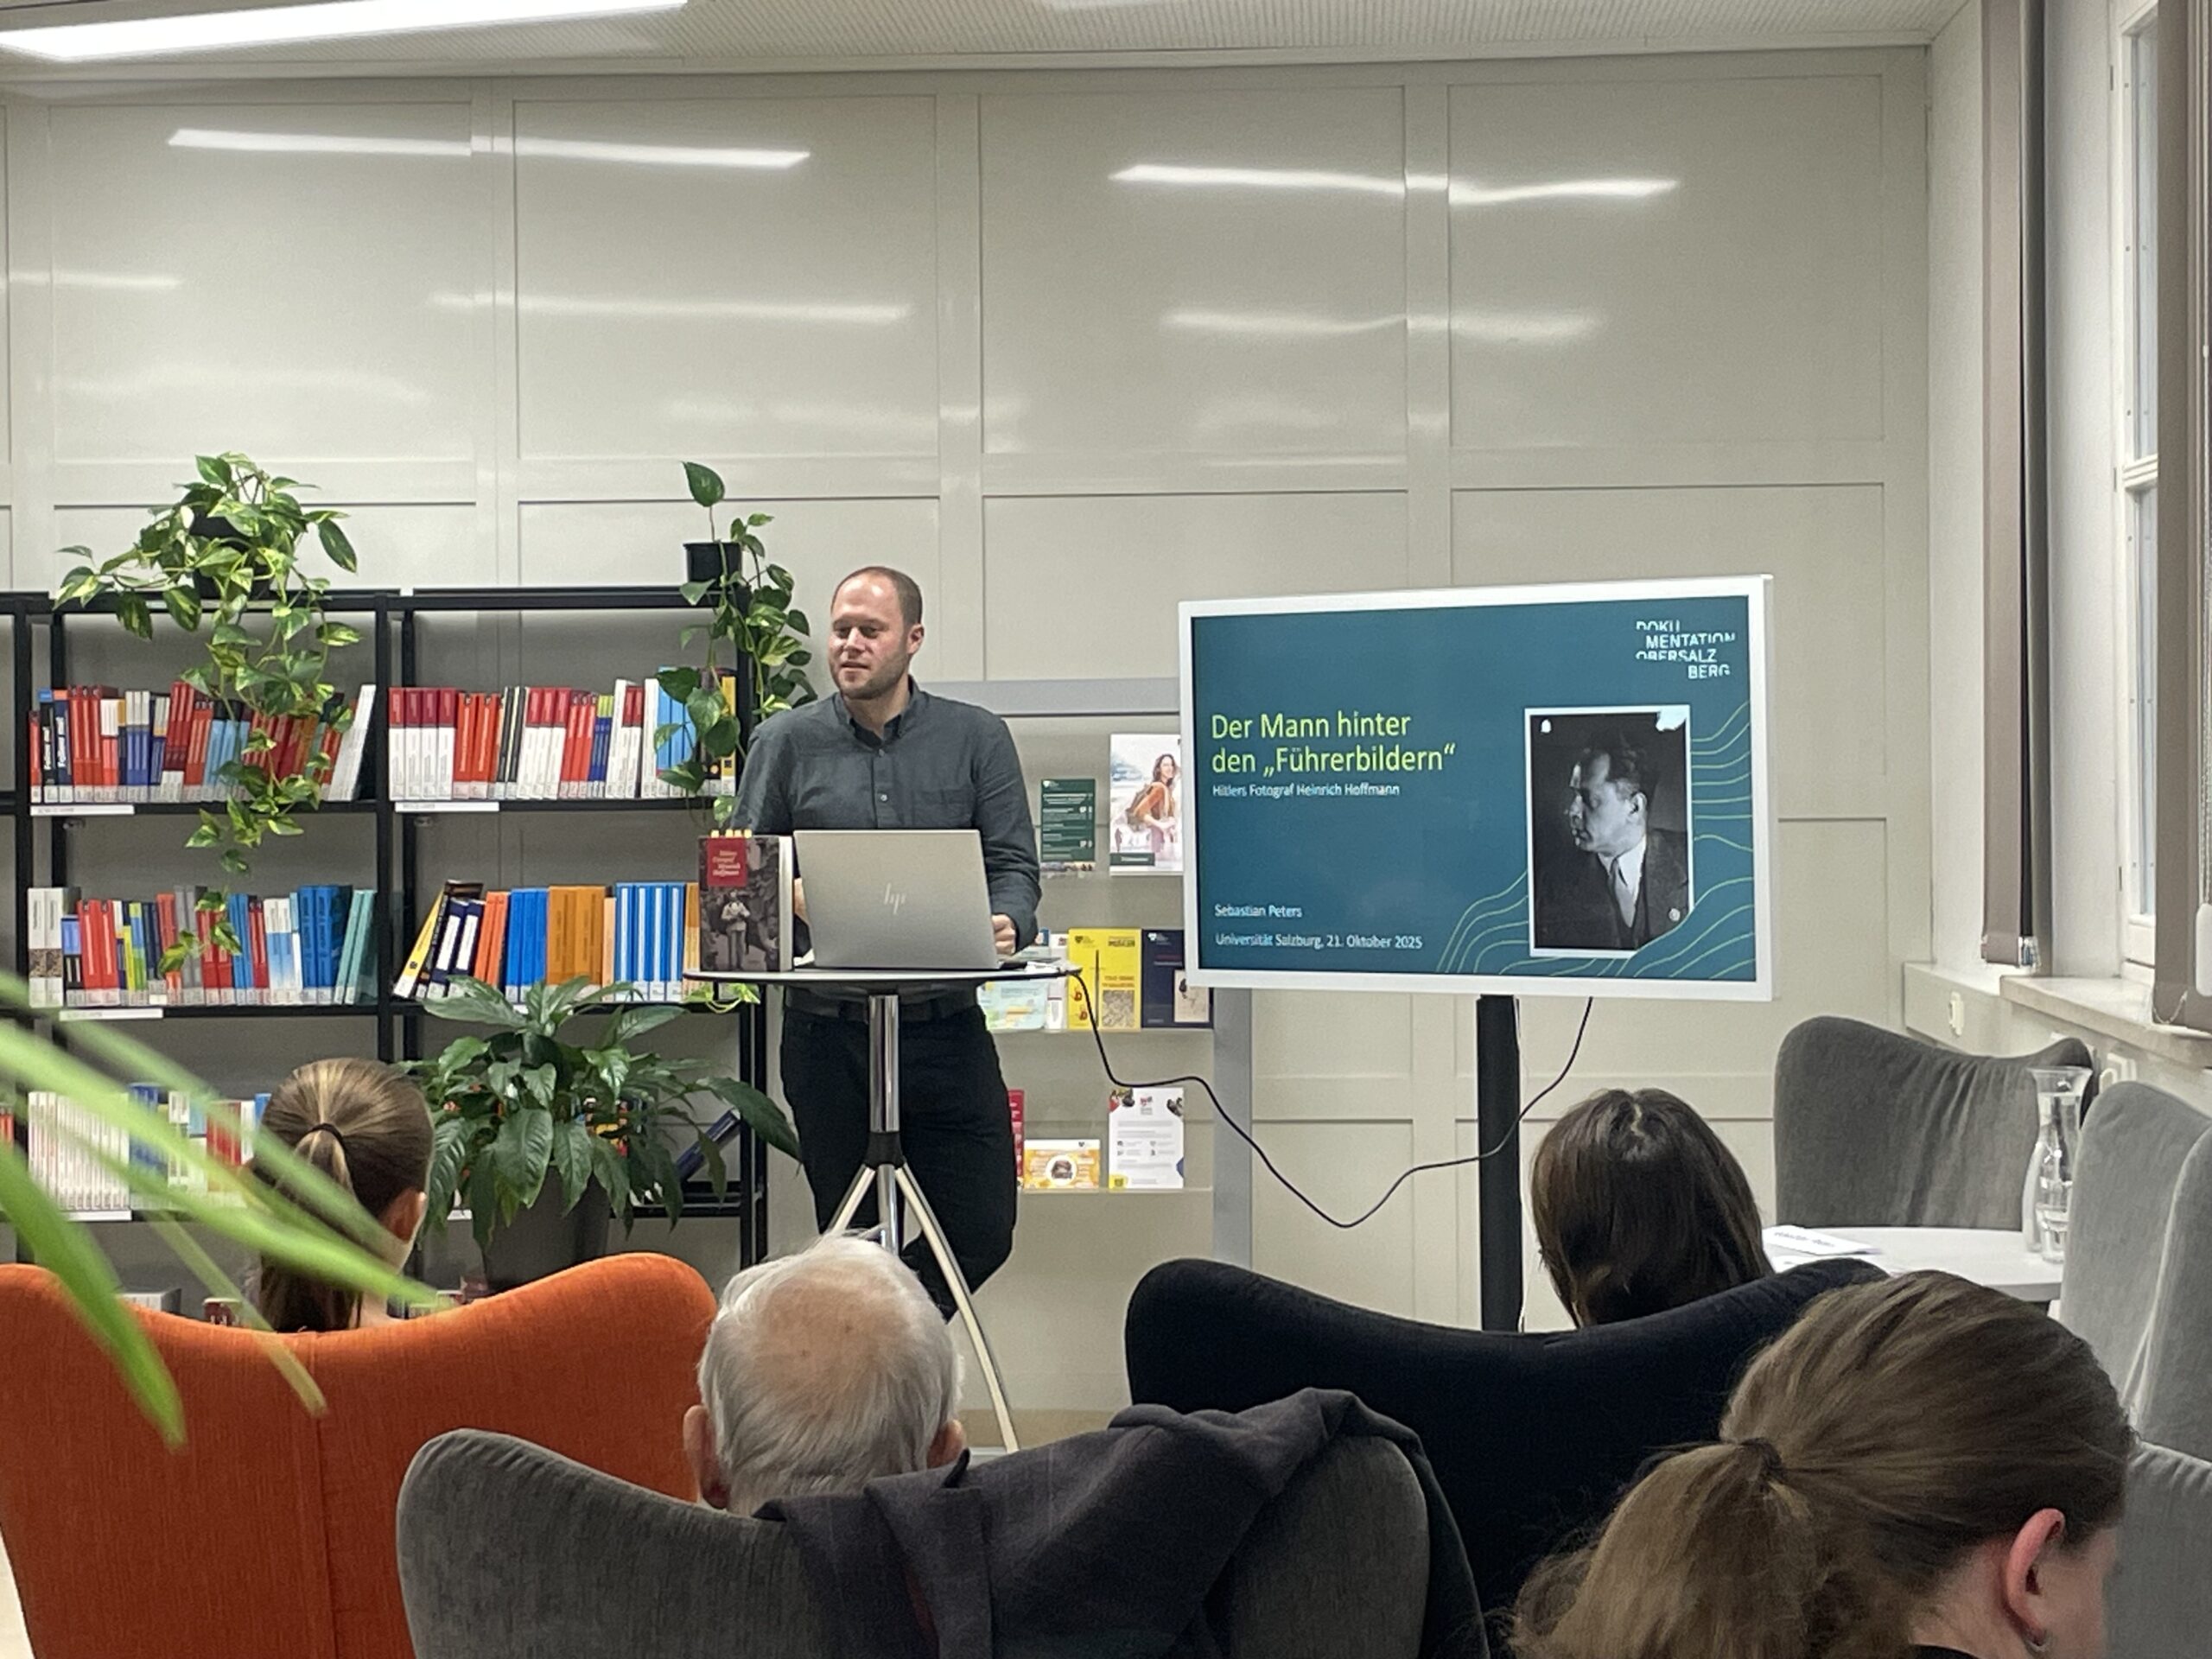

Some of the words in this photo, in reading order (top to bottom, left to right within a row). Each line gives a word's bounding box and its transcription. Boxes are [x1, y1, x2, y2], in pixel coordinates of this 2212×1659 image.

[1645, 632, 1736, 649] MENTATION
[1688, 664, 1731, 679] BERG
[1211, 714, 1253, 740] Der
[1260, 713, 1330, 739] Mann
[1338, 710, 1412, 737] hinter
[1211, 747, 1256, 773] den
[1263, 742, 1457, 779] „Führerbildern“
[1212, 784, 1248, 797] Hitlers
[1249, 782, 1294, 799] Fotograf
[1296, 782, 1342, 796] Heinrich
[1344, 781, 1400, 796] Hoffmann
[883, 881, 907, 916] hp
[1214, 903, 1266, 917] Sebastian
[1268, 905, 1303, 918] Peters
[1215, 932, 1274, 946] Universität
[1275, 933, 1324, 950] Salzburg,
[1326, 934, 1344, 947] 21.
[1346, 934, 1392, 948] Oktober
[1395, 935, 1423, 950] 2025
